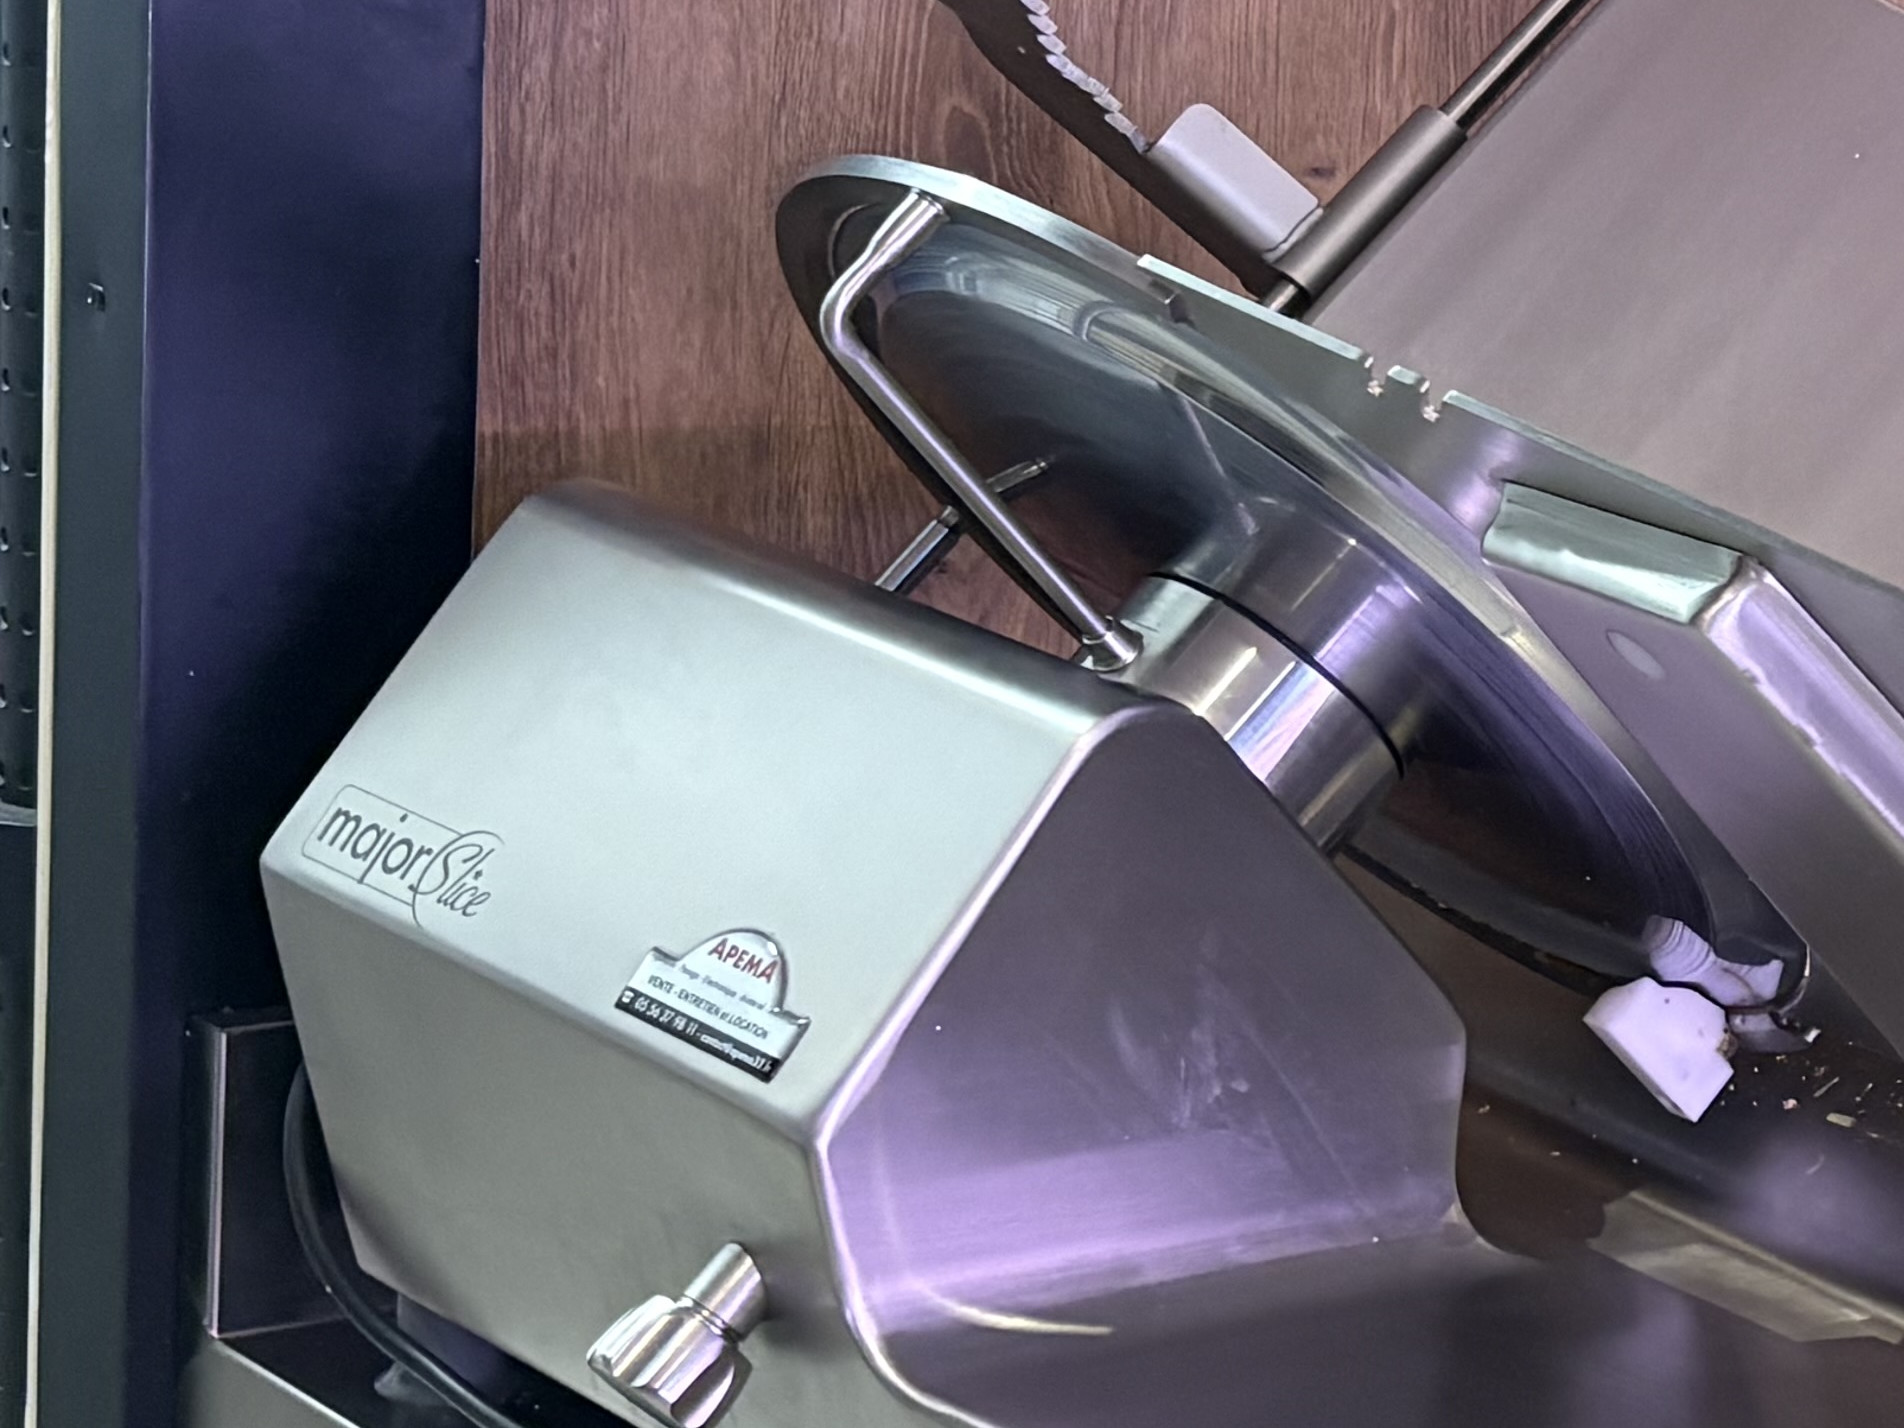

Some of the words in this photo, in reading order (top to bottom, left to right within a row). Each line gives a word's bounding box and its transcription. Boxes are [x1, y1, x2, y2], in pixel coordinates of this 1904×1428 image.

[707, 937, 779, 984] APEMA
[648, 975, 674, 994] VENTE
[677, 989, 720, 1017] ENTRETIEN
